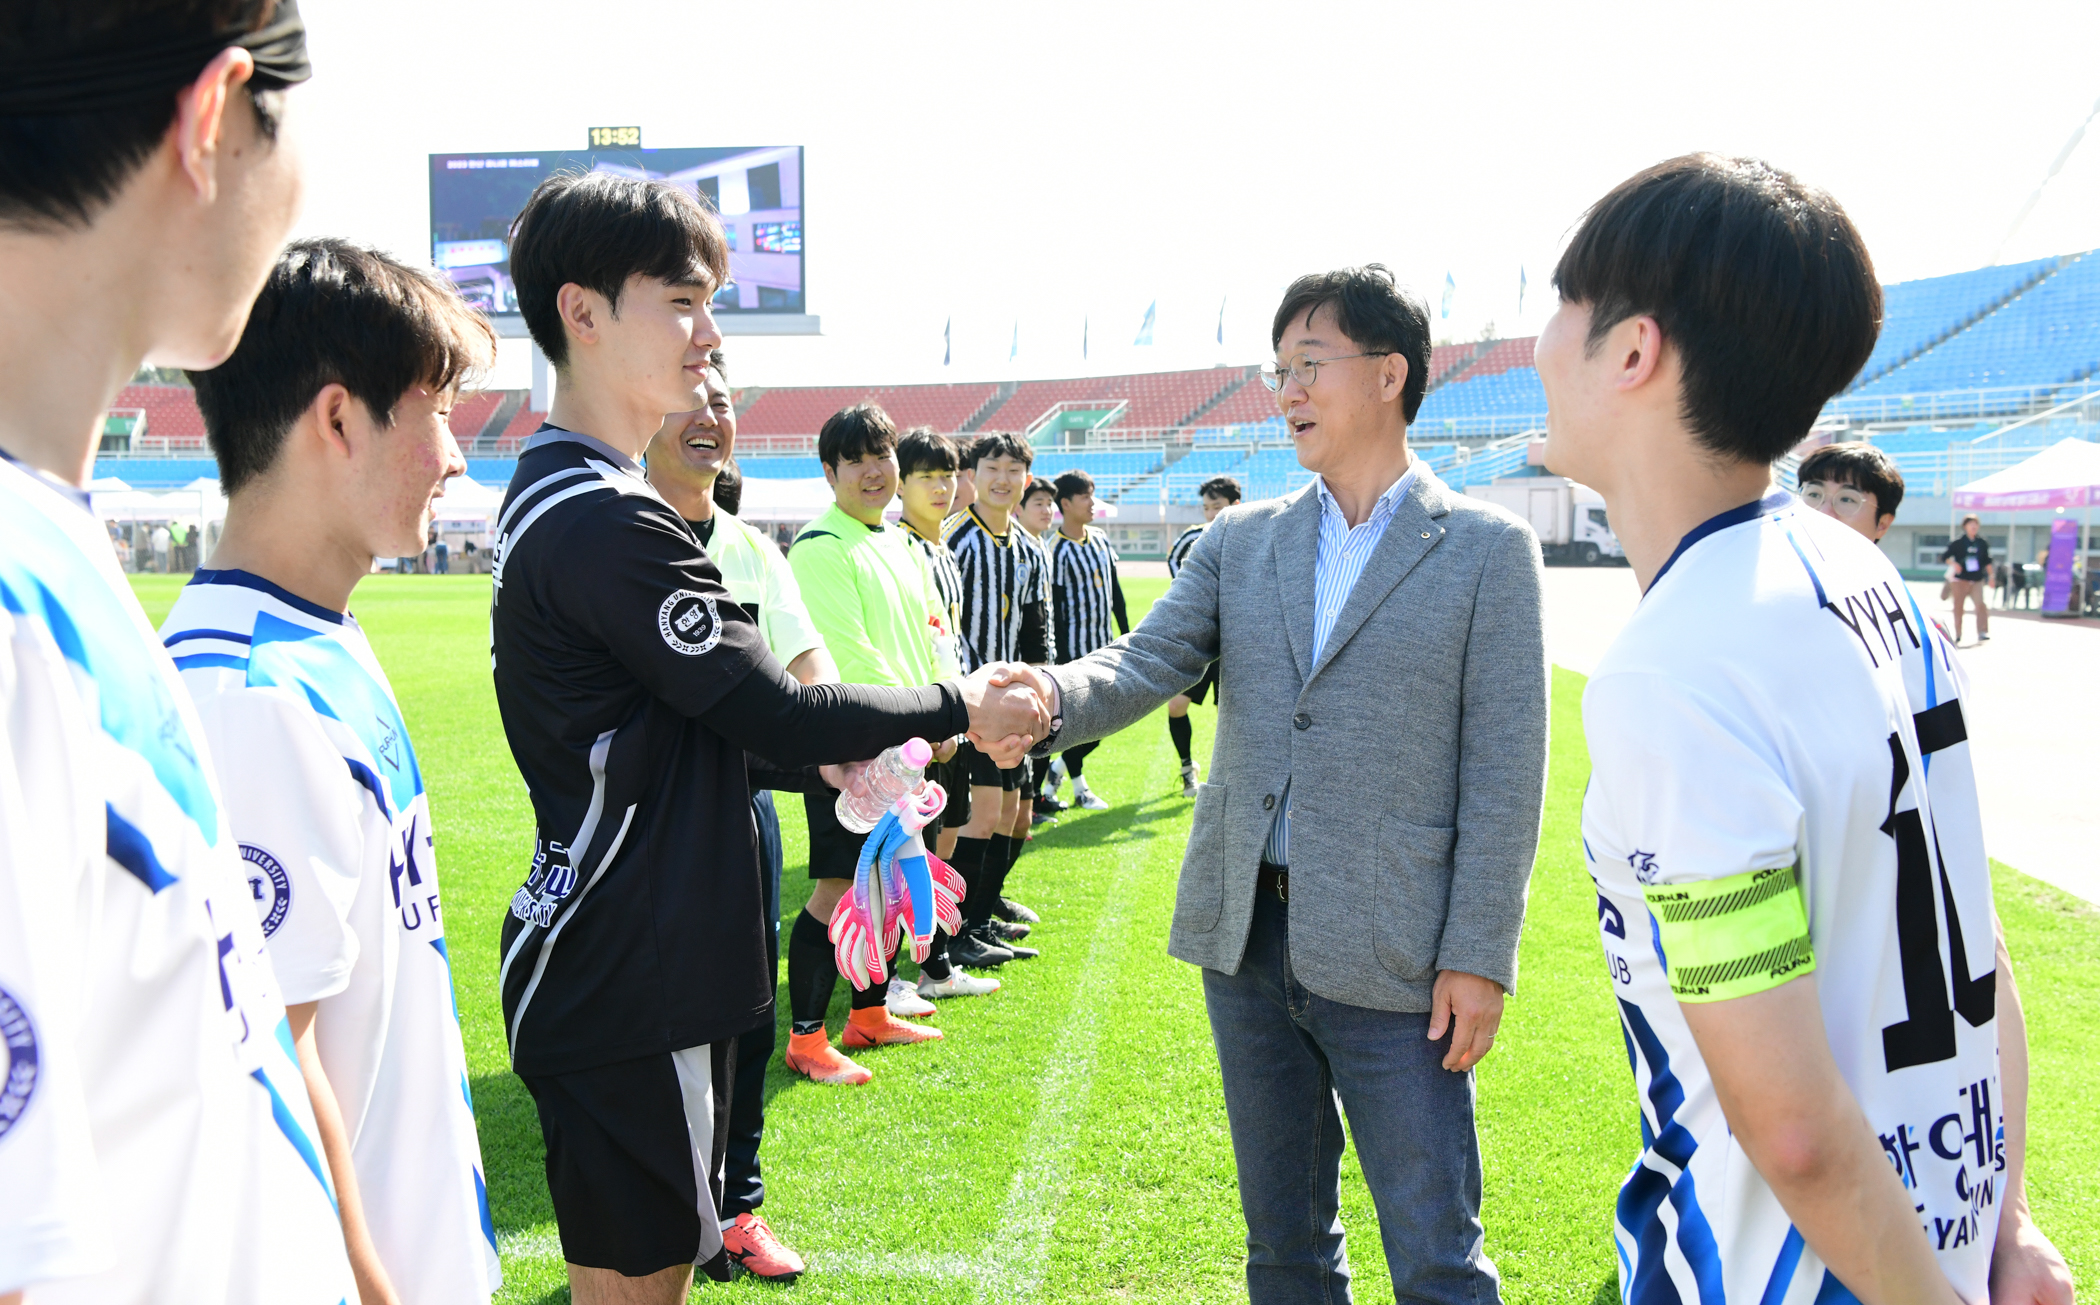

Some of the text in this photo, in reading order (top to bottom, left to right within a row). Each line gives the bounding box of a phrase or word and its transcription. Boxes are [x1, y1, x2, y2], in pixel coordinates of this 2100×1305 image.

[591, 127, 640, 146] 13:52
[660, 599, 675, 638] HANYANG
[692, 624, 707, 637] 1939
[239, 847, 288, 889] NIVERSITY
